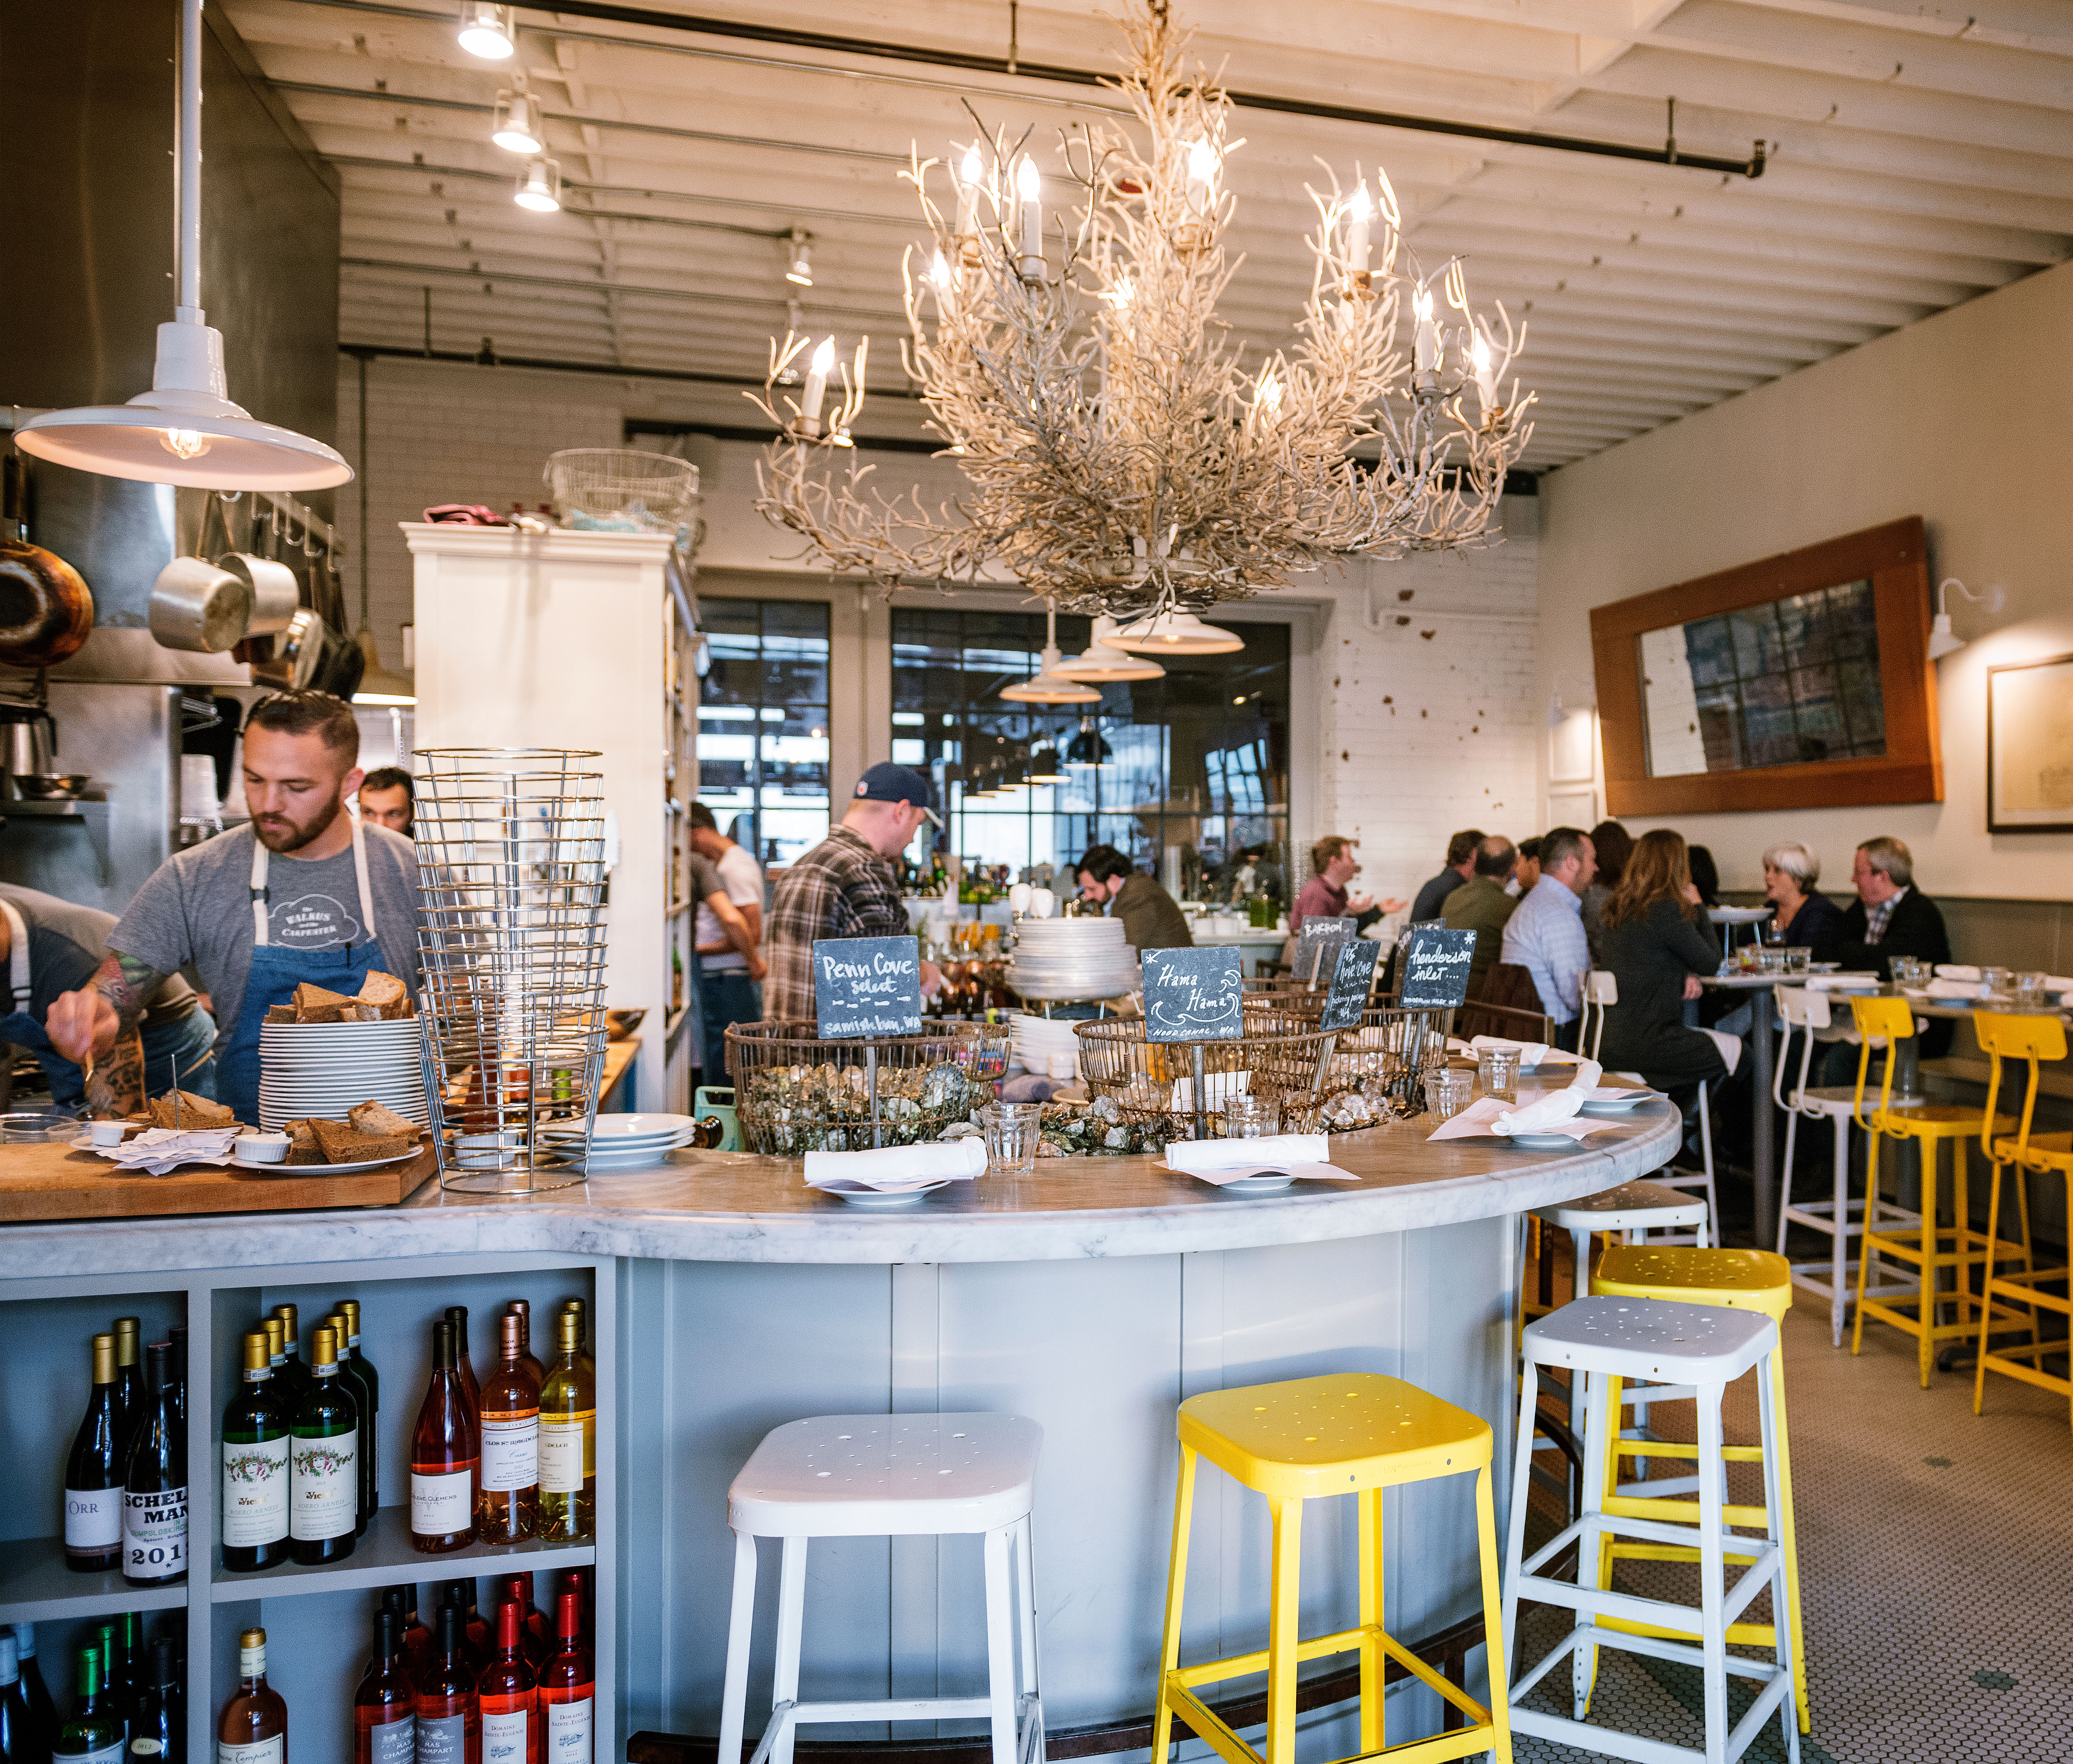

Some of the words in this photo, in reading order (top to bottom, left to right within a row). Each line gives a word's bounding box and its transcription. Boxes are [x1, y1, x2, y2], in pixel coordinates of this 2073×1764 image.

[822, 956, 871, 980] Penn
[874, 952, 914, 976] Cove
[1157, 963, 1198, 987] Hama
[851, 976, 897, 994] select
[1186, 987, 1227, 1011] Hama
[903, 1016, 921, 1028] WA
[1219, 1025, 1234, 1034] WA
[321, 1499, 345, 1508] ARNEIS
[132, 1544, 188, 1565] 201
[396, 1739, 411, 1750] MAS
[235, 1751, 273, 1764] Tempier
